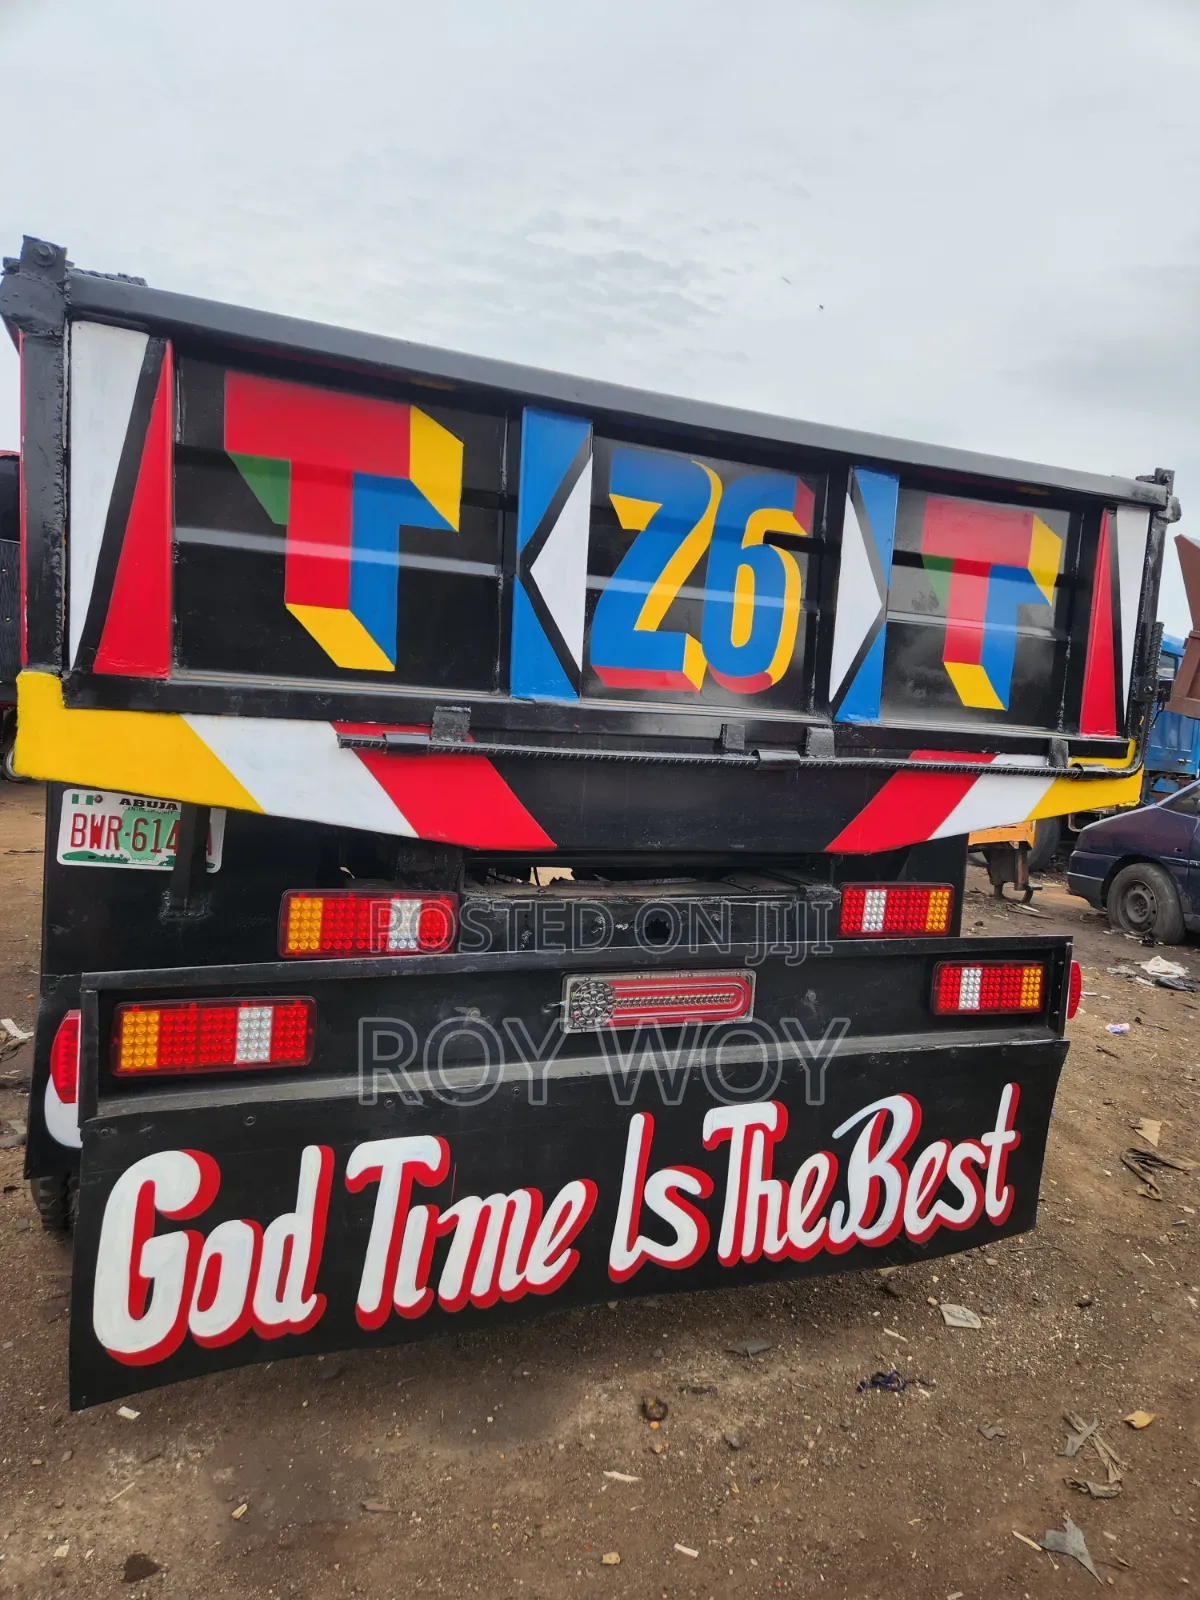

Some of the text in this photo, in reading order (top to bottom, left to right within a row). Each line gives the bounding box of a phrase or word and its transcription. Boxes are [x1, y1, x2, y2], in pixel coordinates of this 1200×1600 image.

[223, 370, 464, 671] T
[920, 496, 1062, 711] T
[119, 798, 178, 810] ABUJA
[93, 1082, 1020, 1366] God Time Is The Best
